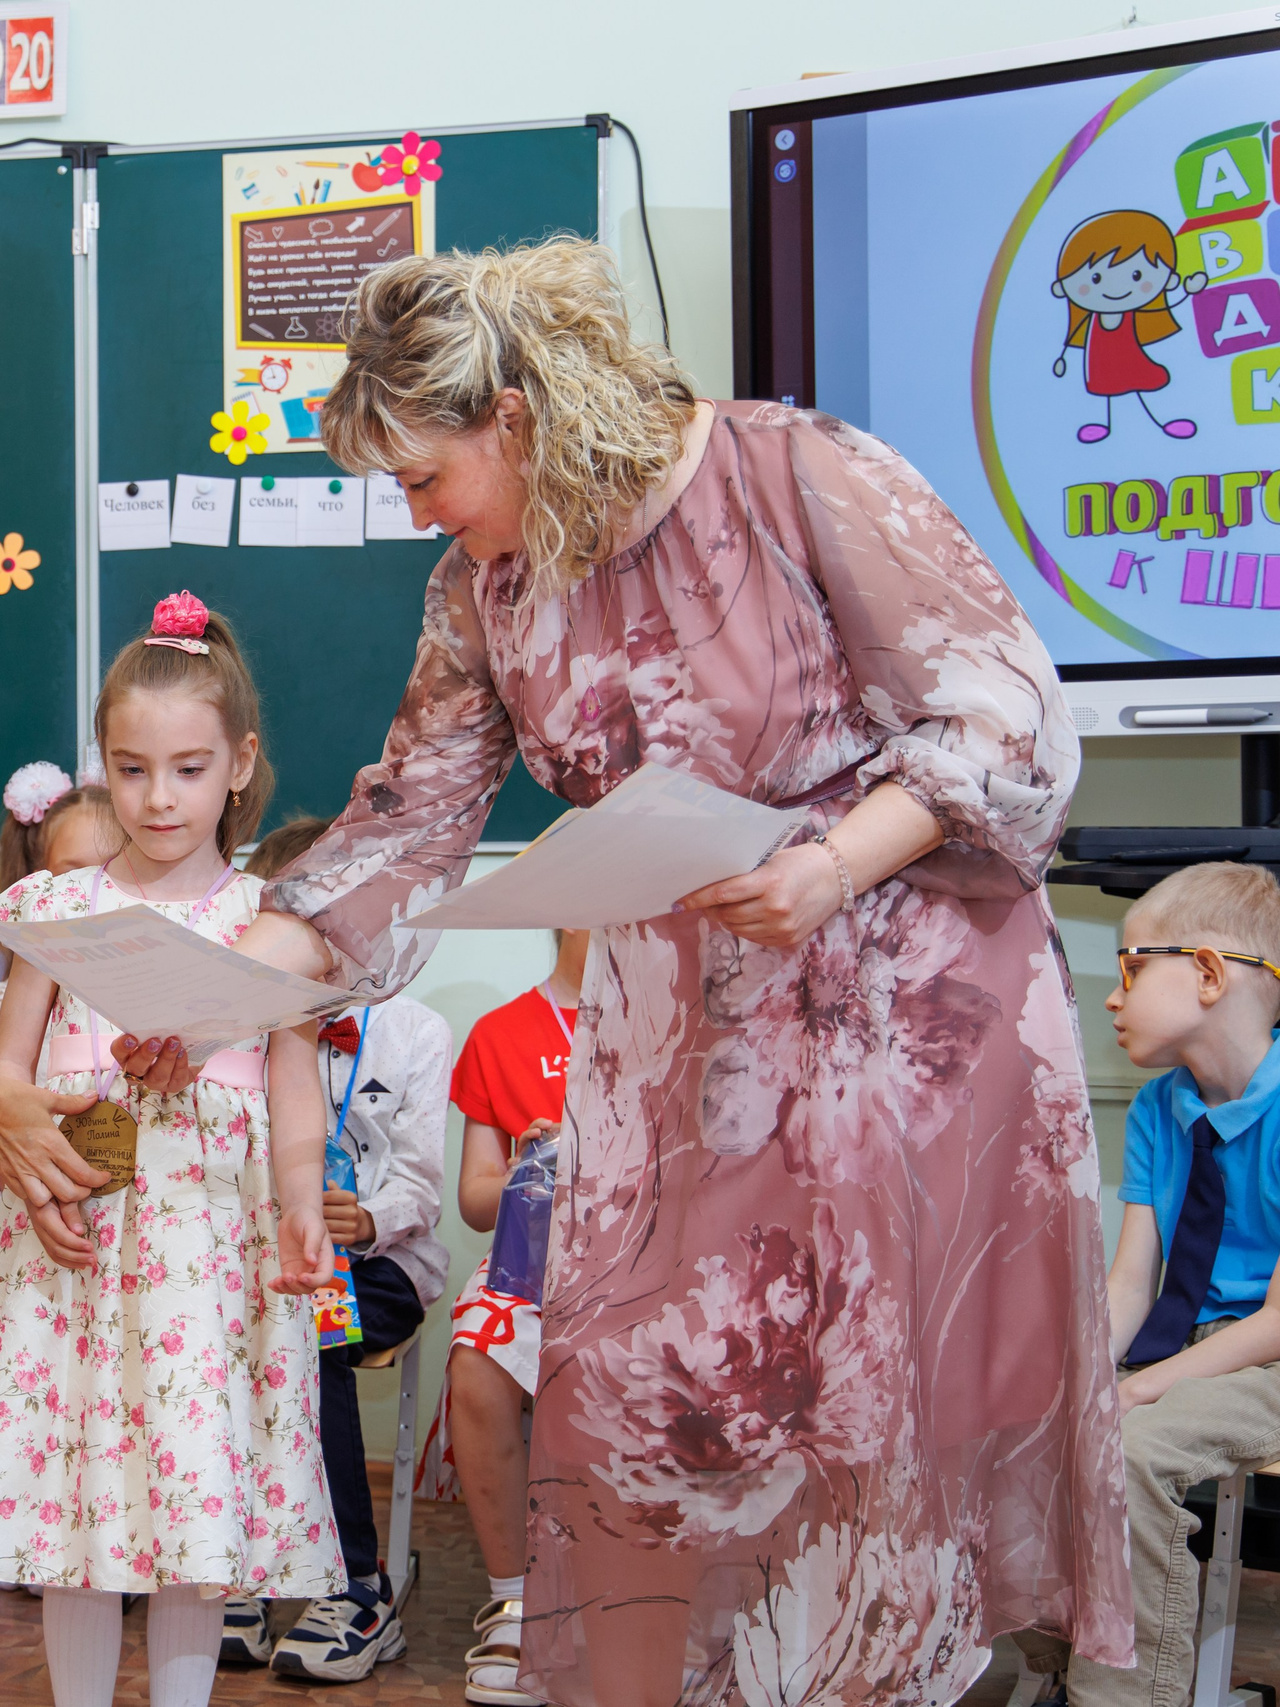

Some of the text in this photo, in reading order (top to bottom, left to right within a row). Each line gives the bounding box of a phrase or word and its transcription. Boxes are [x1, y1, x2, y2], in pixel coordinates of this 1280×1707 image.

[10, 31, 51, 90] 20
[1196, 147, 1252, 209] А
[1198, 230, 1244, 281] В
[1212, 293, 1271, 348] Д
[103, 497, 165, 514] Человек
[191, 496, 216, 512] без
[318, 499, 344, 512] что
[1180, 549, 1280, 610] Ш
[75, 1117, 108, 1129] Юдина
[86, 1129, 120, 1141] Полина
[86, 1148, 133, 1161] ВЫПУСКНИЦА
